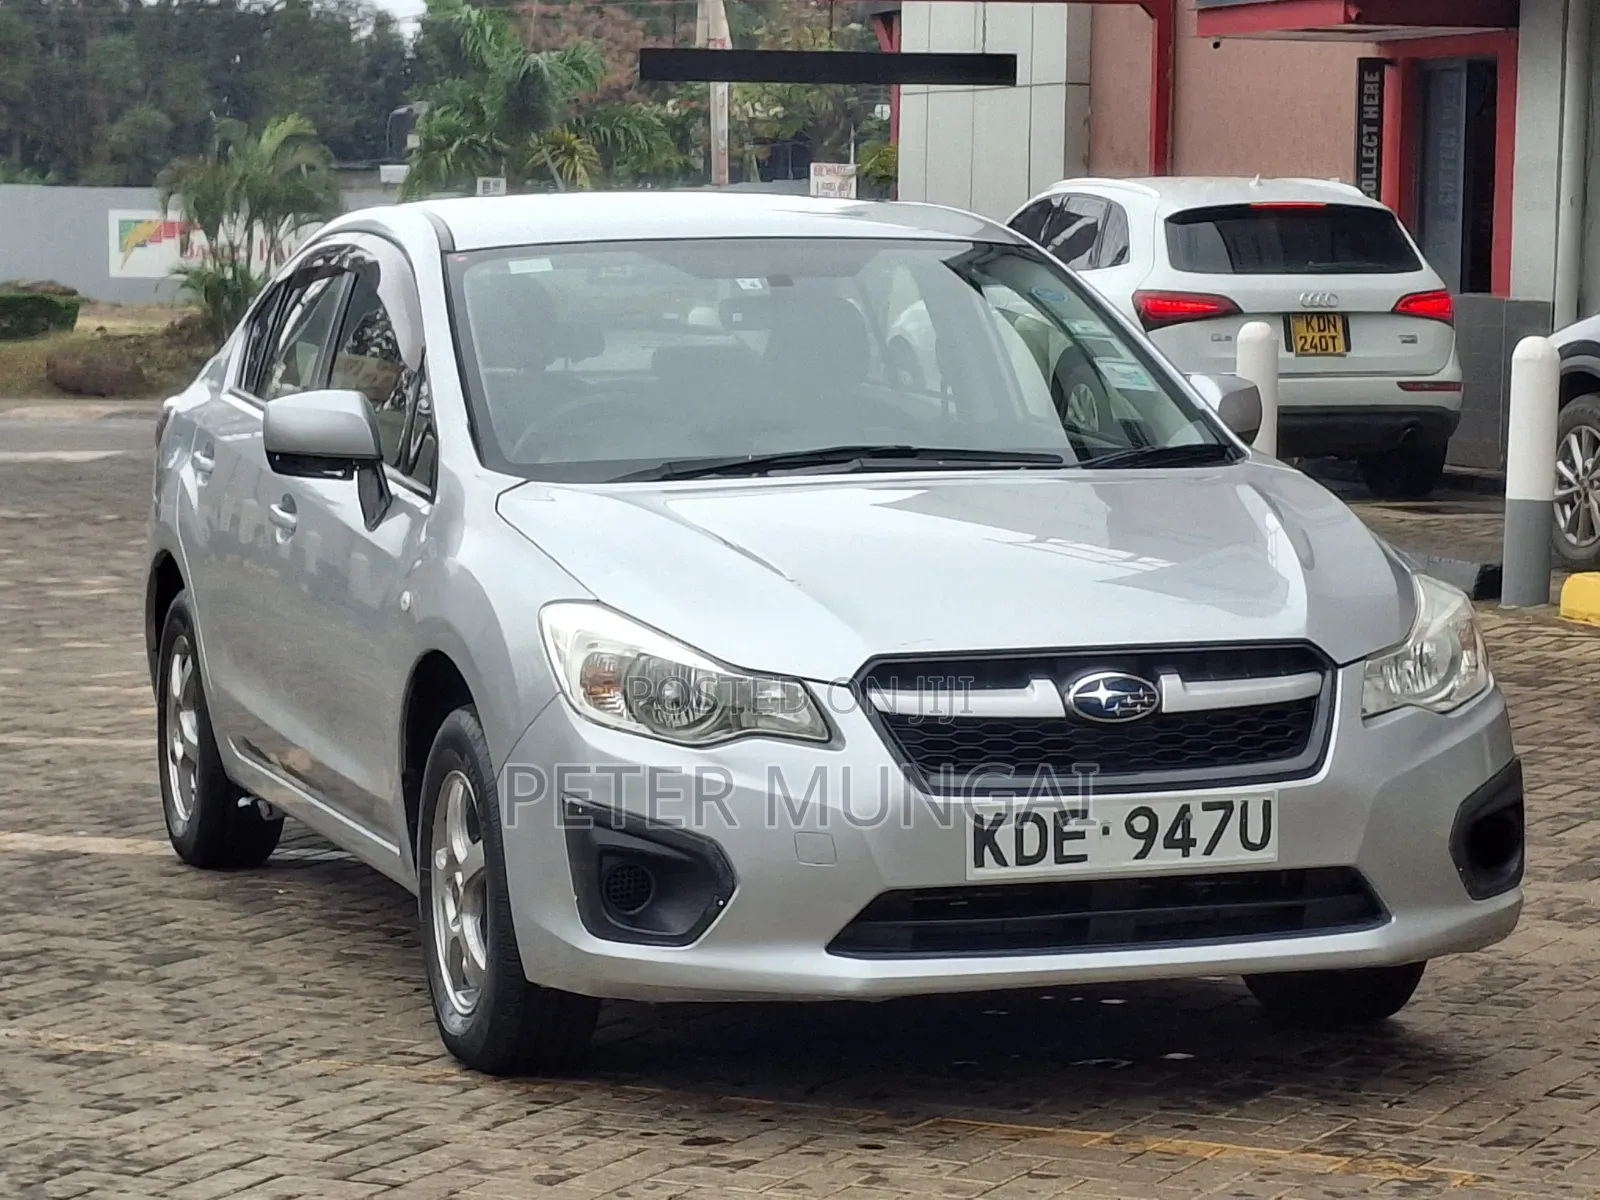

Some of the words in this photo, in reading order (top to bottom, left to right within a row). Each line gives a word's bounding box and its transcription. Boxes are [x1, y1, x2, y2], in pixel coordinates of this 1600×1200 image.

[1363, 71, 1380, 119] HERE
[1304, 315, 1338, 333] KDN
[1299, 335, 1338, 353] 240T
[1124, 799, 1272, 860] 947U
